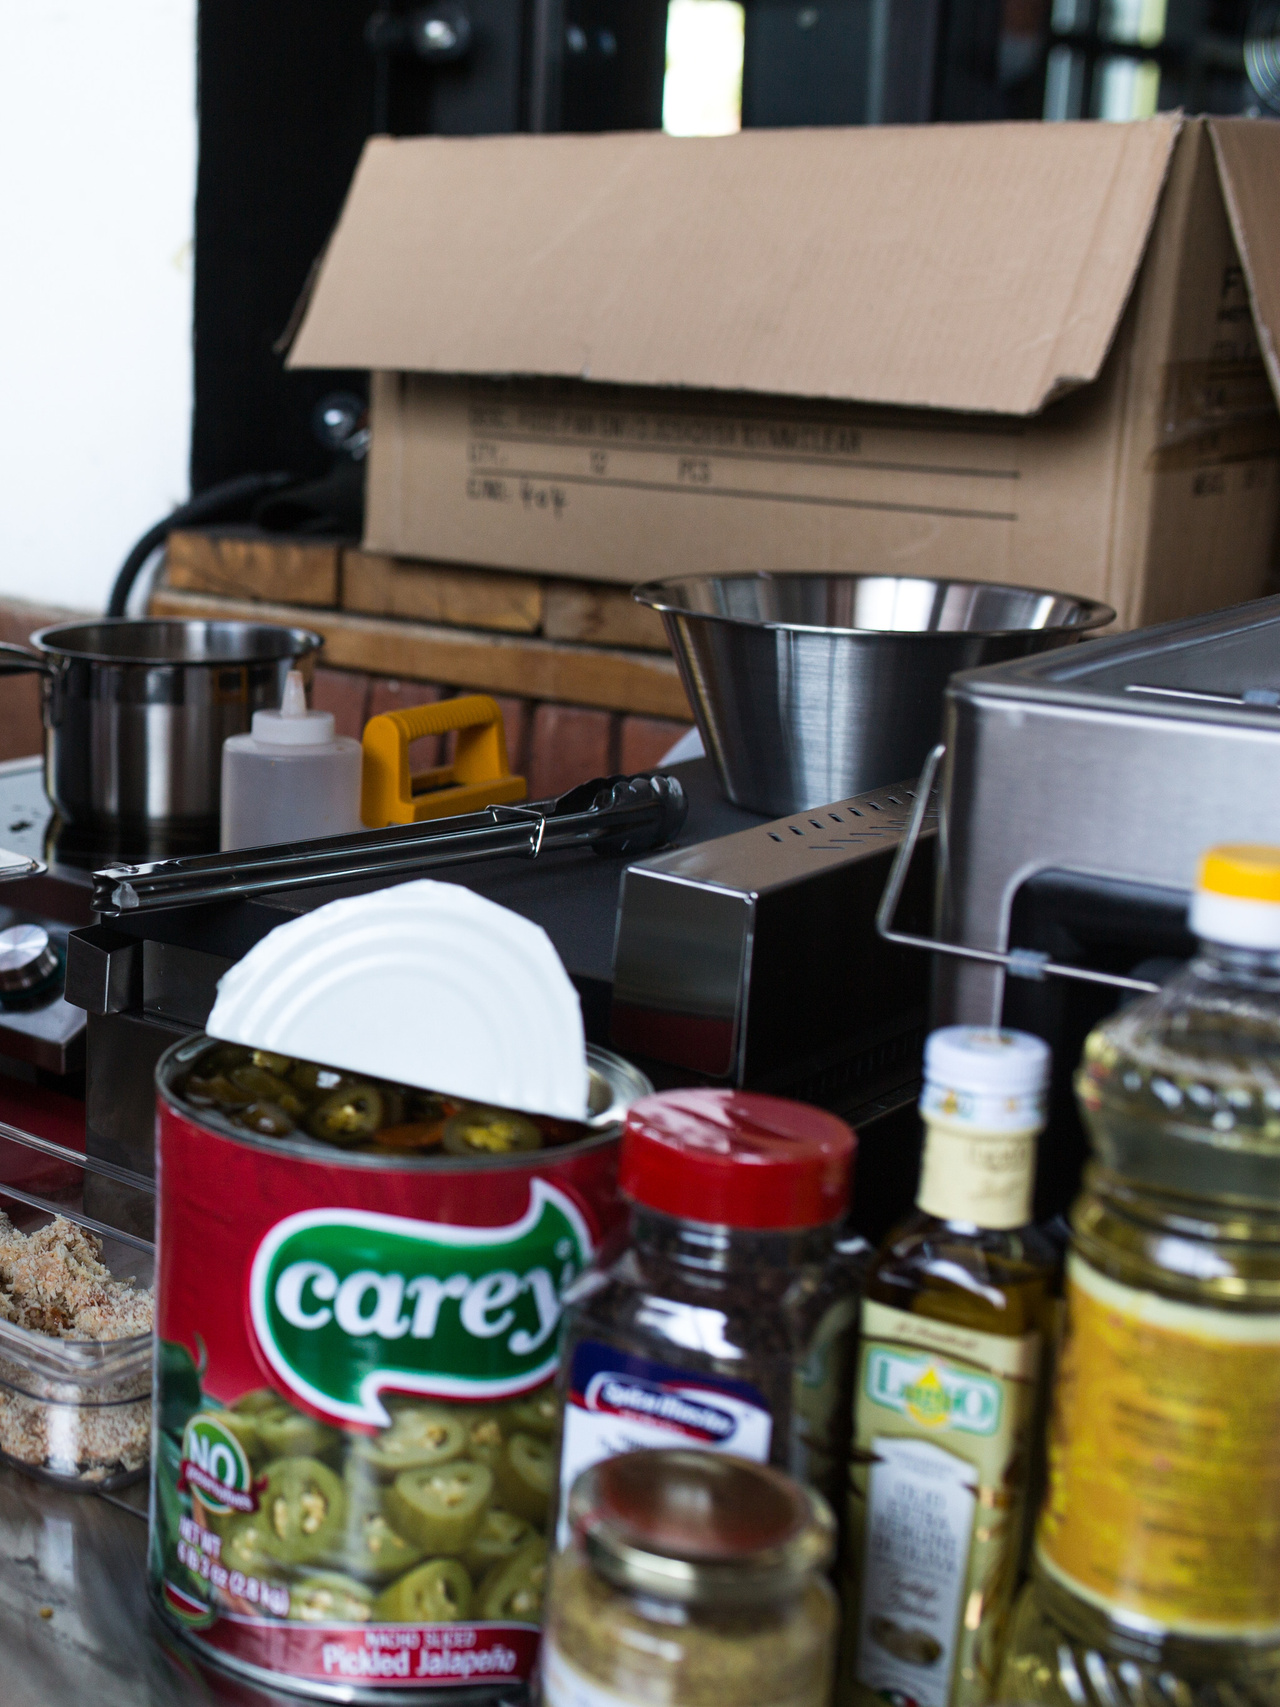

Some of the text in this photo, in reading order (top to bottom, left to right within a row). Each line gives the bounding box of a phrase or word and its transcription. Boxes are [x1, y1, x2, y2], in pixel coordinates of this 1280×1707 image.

[273, 1258, 571, 1356] carey
[189, 1429, 238, 1488] NO
[322, 1643, 517, 1679] Pickled Jalapeño
